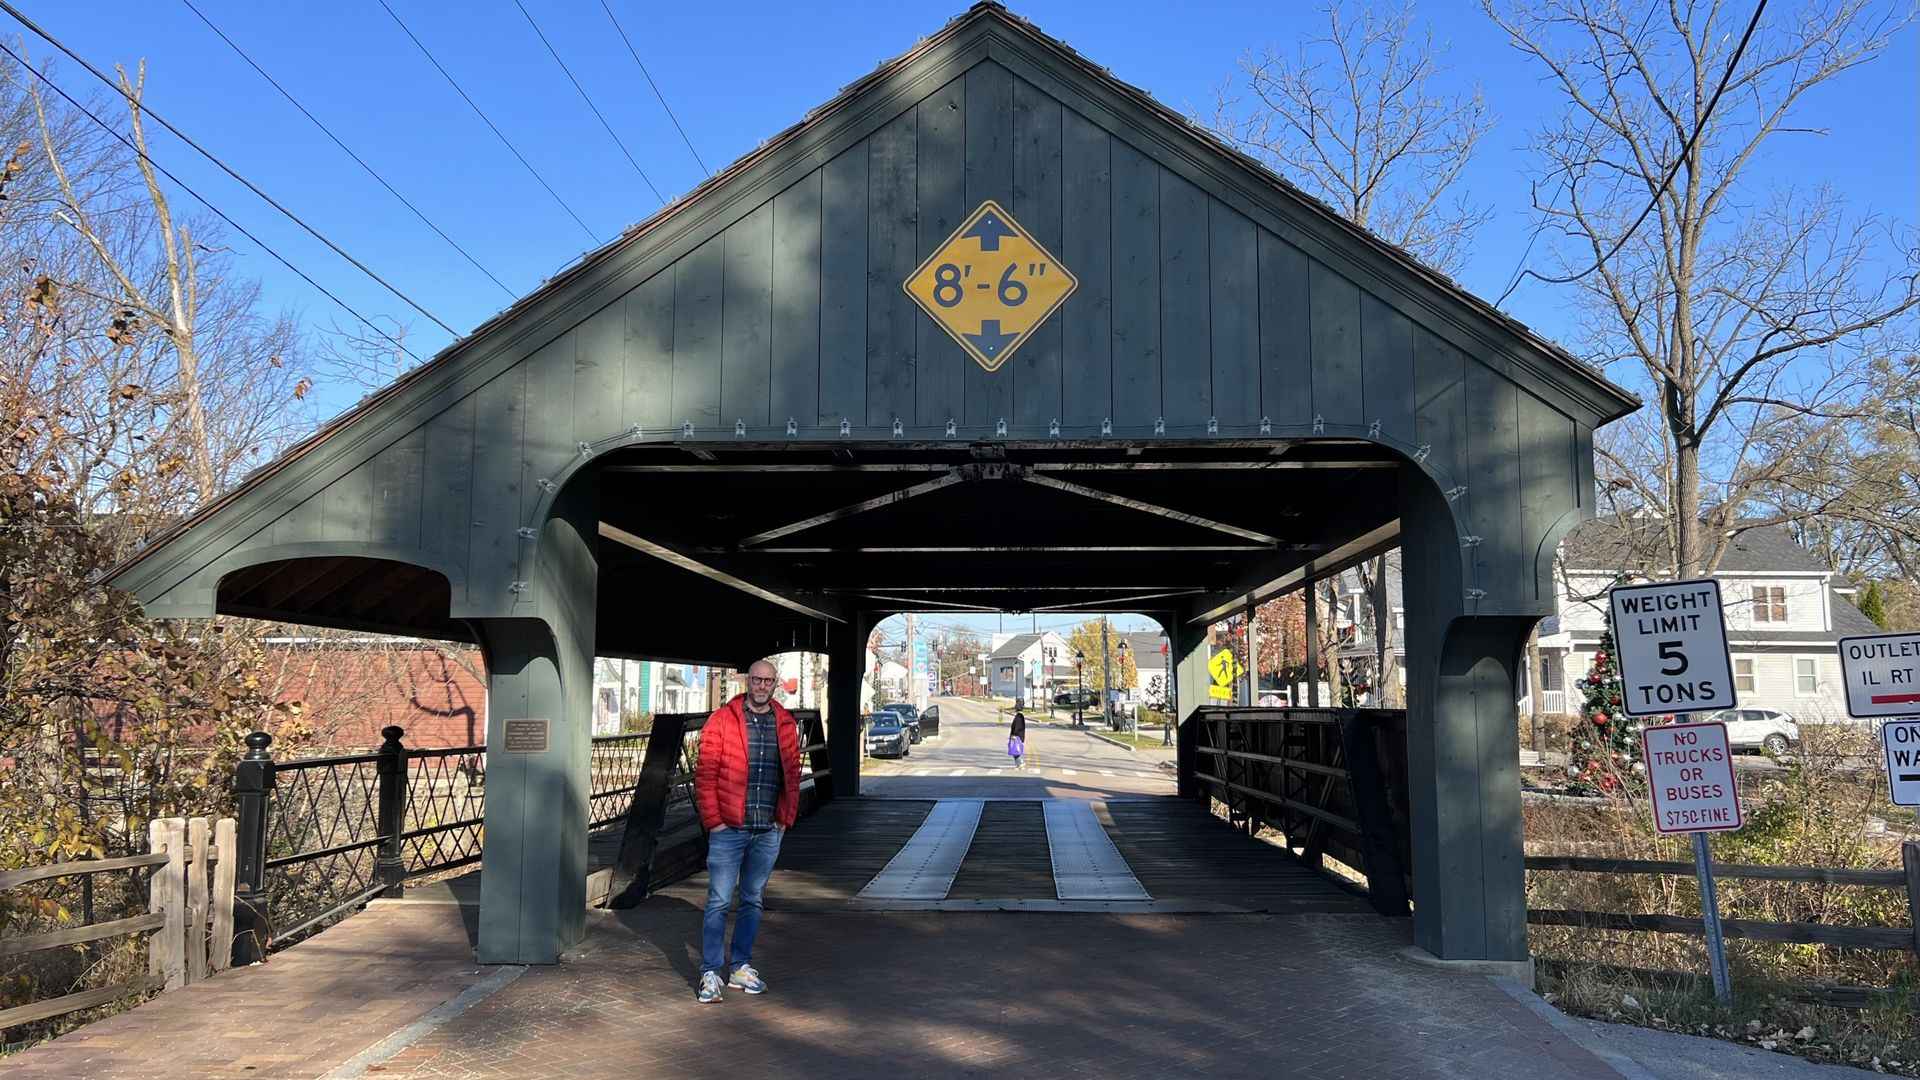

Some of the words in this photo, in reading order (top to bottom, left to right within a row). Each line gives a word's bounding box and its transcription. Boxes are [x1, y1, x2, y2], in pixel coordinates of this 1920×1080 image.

[1621, 591, 1711, 614] WEIGHT
[1638, 614, 1701, 635] LIMIT
[1658, 640, 1689, 676] 5
[1850, 641, 1920, 660] OUTLET
[1862, 671, 1881, 686] IL
[1891, 668, 1914, 684] RT
[1639, 681, 1716, 705] TONS
[1673, 731, 1698, 746] NO
[1654, 748, 1723, 766] TRUCKS
[1680, 767, 1704, 782] OR
[1666, 784, 1723, 801] BUSES
[1666, 809, 1698, 826] $750
[1701, 807, 1730, 823] FINE
